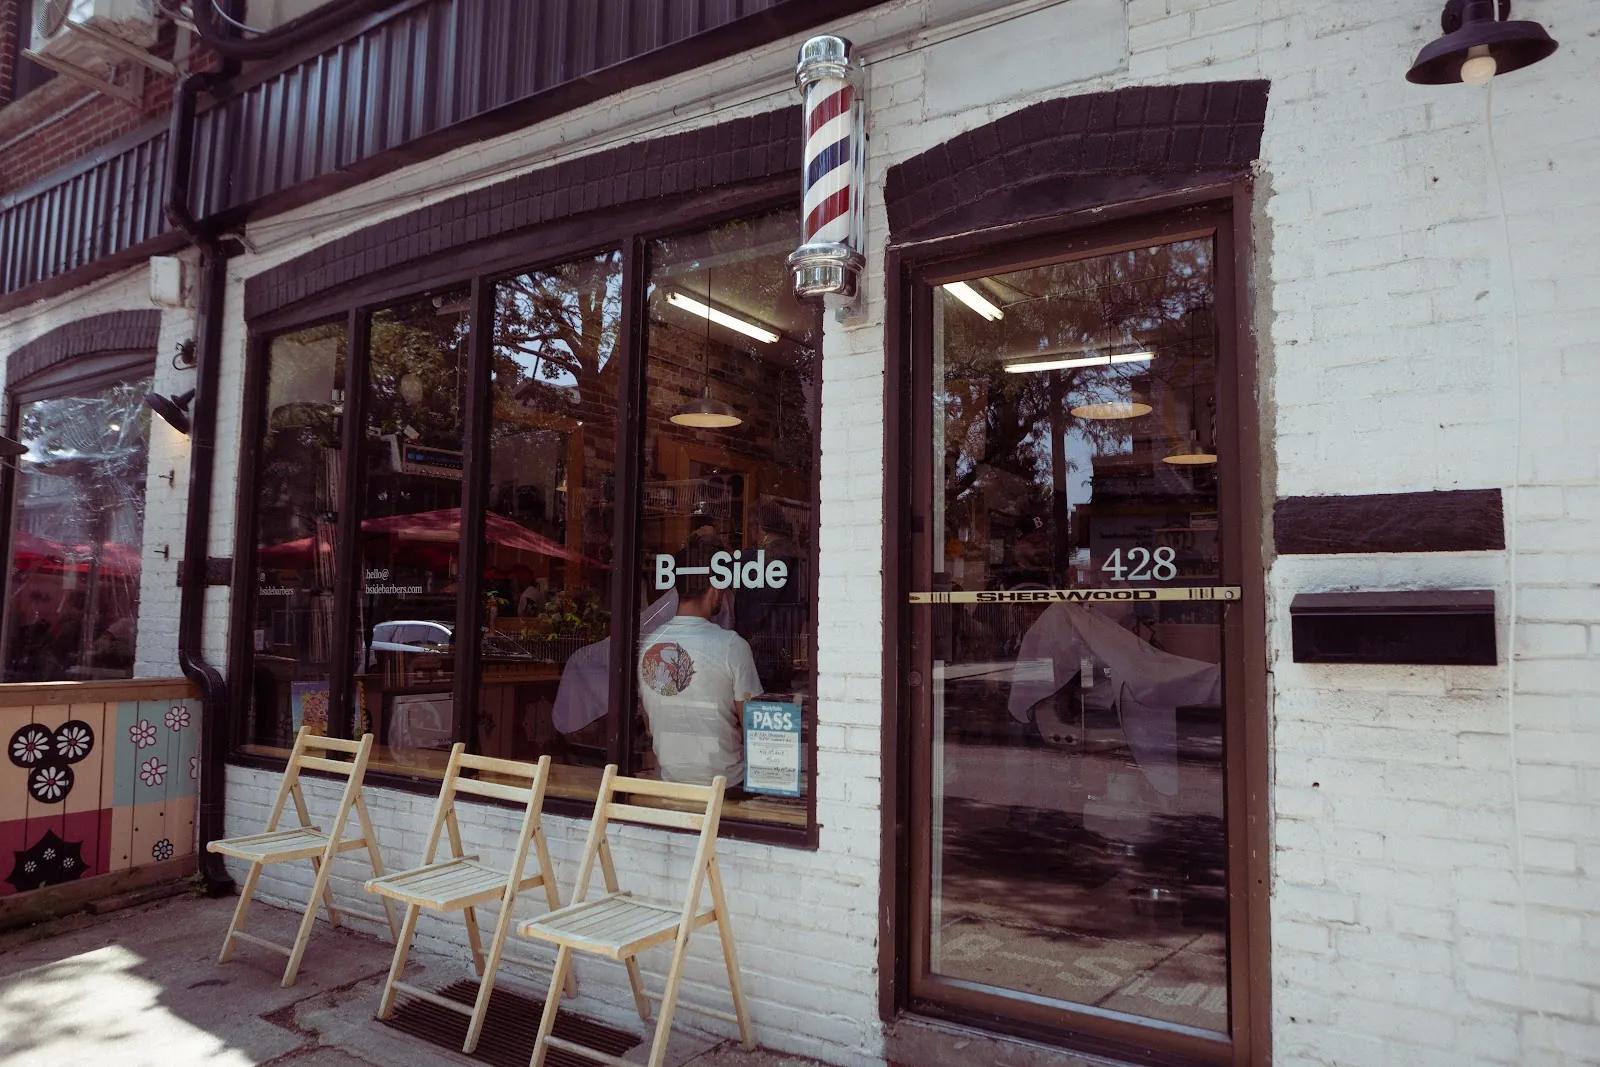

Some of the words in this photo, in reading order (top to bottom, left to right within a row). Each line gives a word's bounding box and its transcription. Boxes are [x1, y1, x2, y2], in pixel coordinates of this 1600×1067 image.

[1032, 516, 1044, 529] B
[1101, 546, 1177, 581] 428
[259, 572, 265, 582] @
[366, 568, 389, 581] hello@
[259, 586, 294, 597] bsidebarbers
[365, 583, 422, 595] bsidebarbers.com
[976, 590, 1157, 601] SHER-WOOD
[753, 711, 793, 731] PASS
